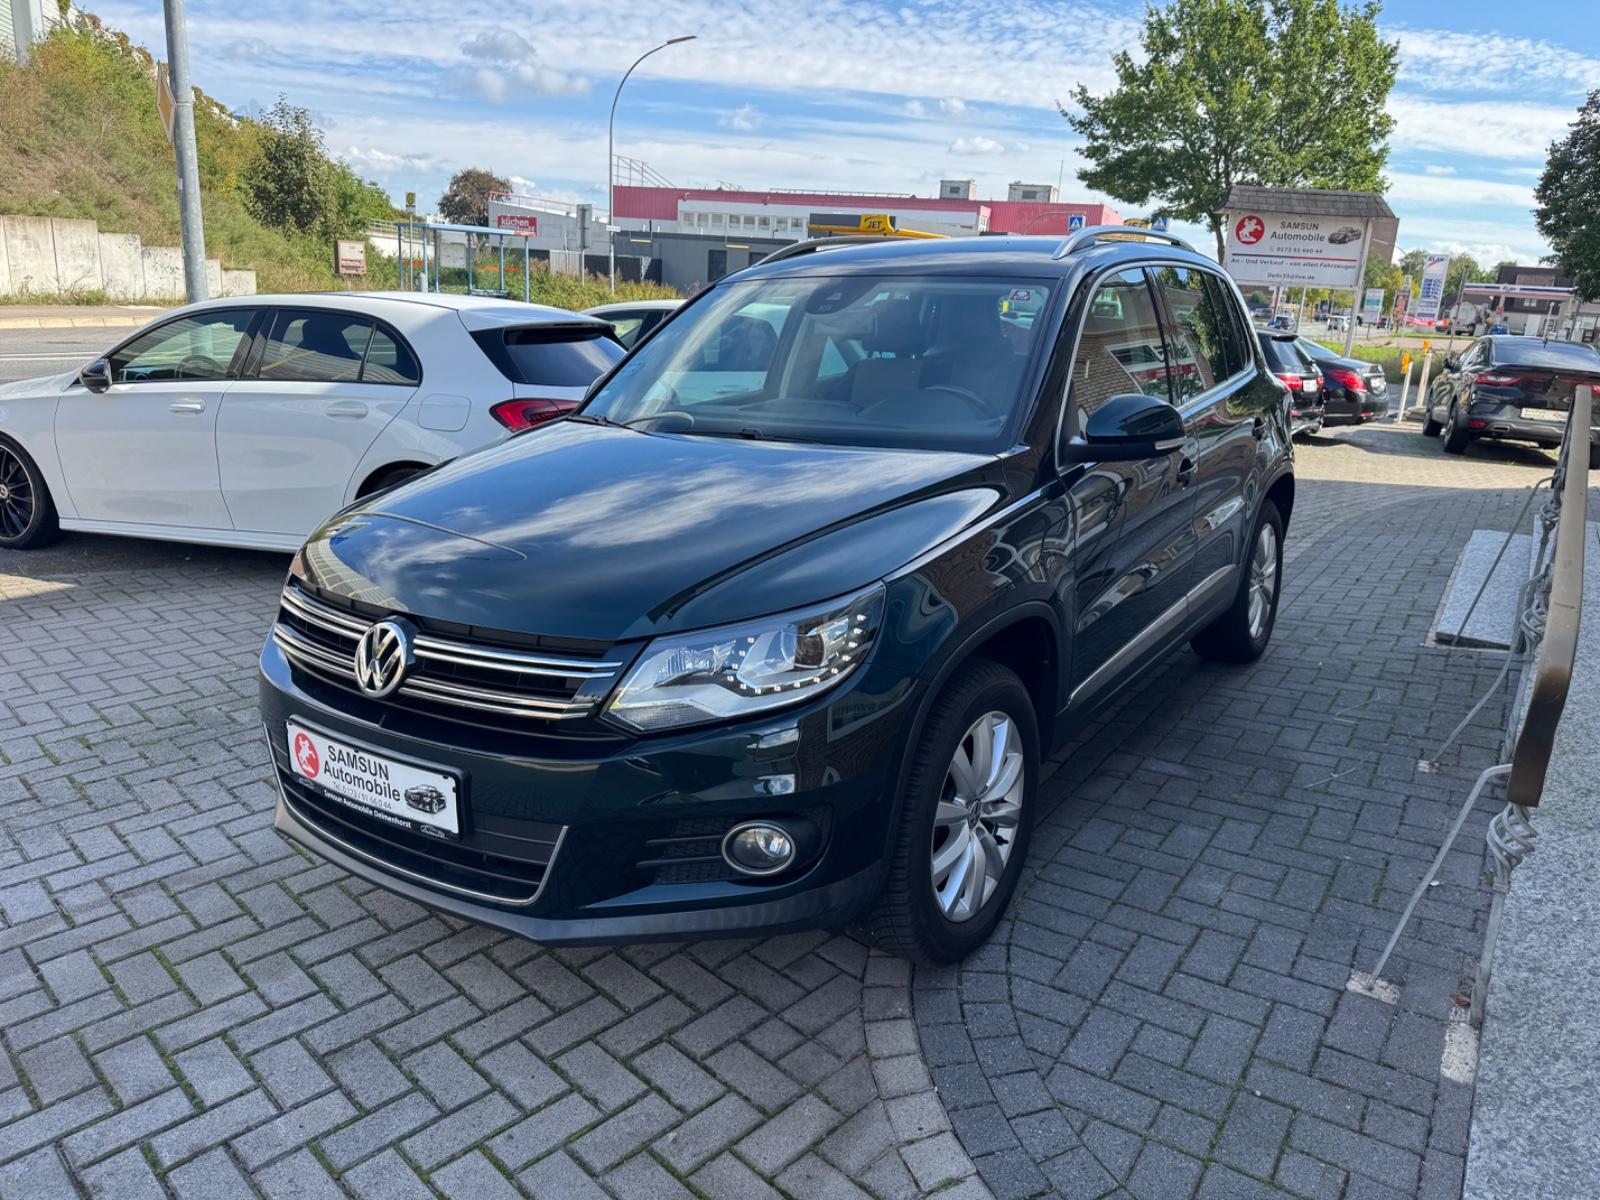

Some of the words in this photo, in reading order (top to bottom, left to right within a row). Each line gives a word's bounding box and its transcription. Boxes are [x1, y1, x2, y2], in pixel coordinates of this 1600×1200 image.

[867, 220, 883, 229] JET
[1280, 221, 1319, 230] SAMSUN
[1270, 231, 1325, 242] Automobile
[1319, 262, 1357, 271] Fahrzeugen
[357, 624, 404, 694] VW
[328, 745, 389, 781] SAMSUN
[324, 760, 401, 801] Automobile
[342, 785, 357, 798] 0173
[343, 797, 373, 817] Automobile
[374, 809, 412, 829] Delmenhorst
